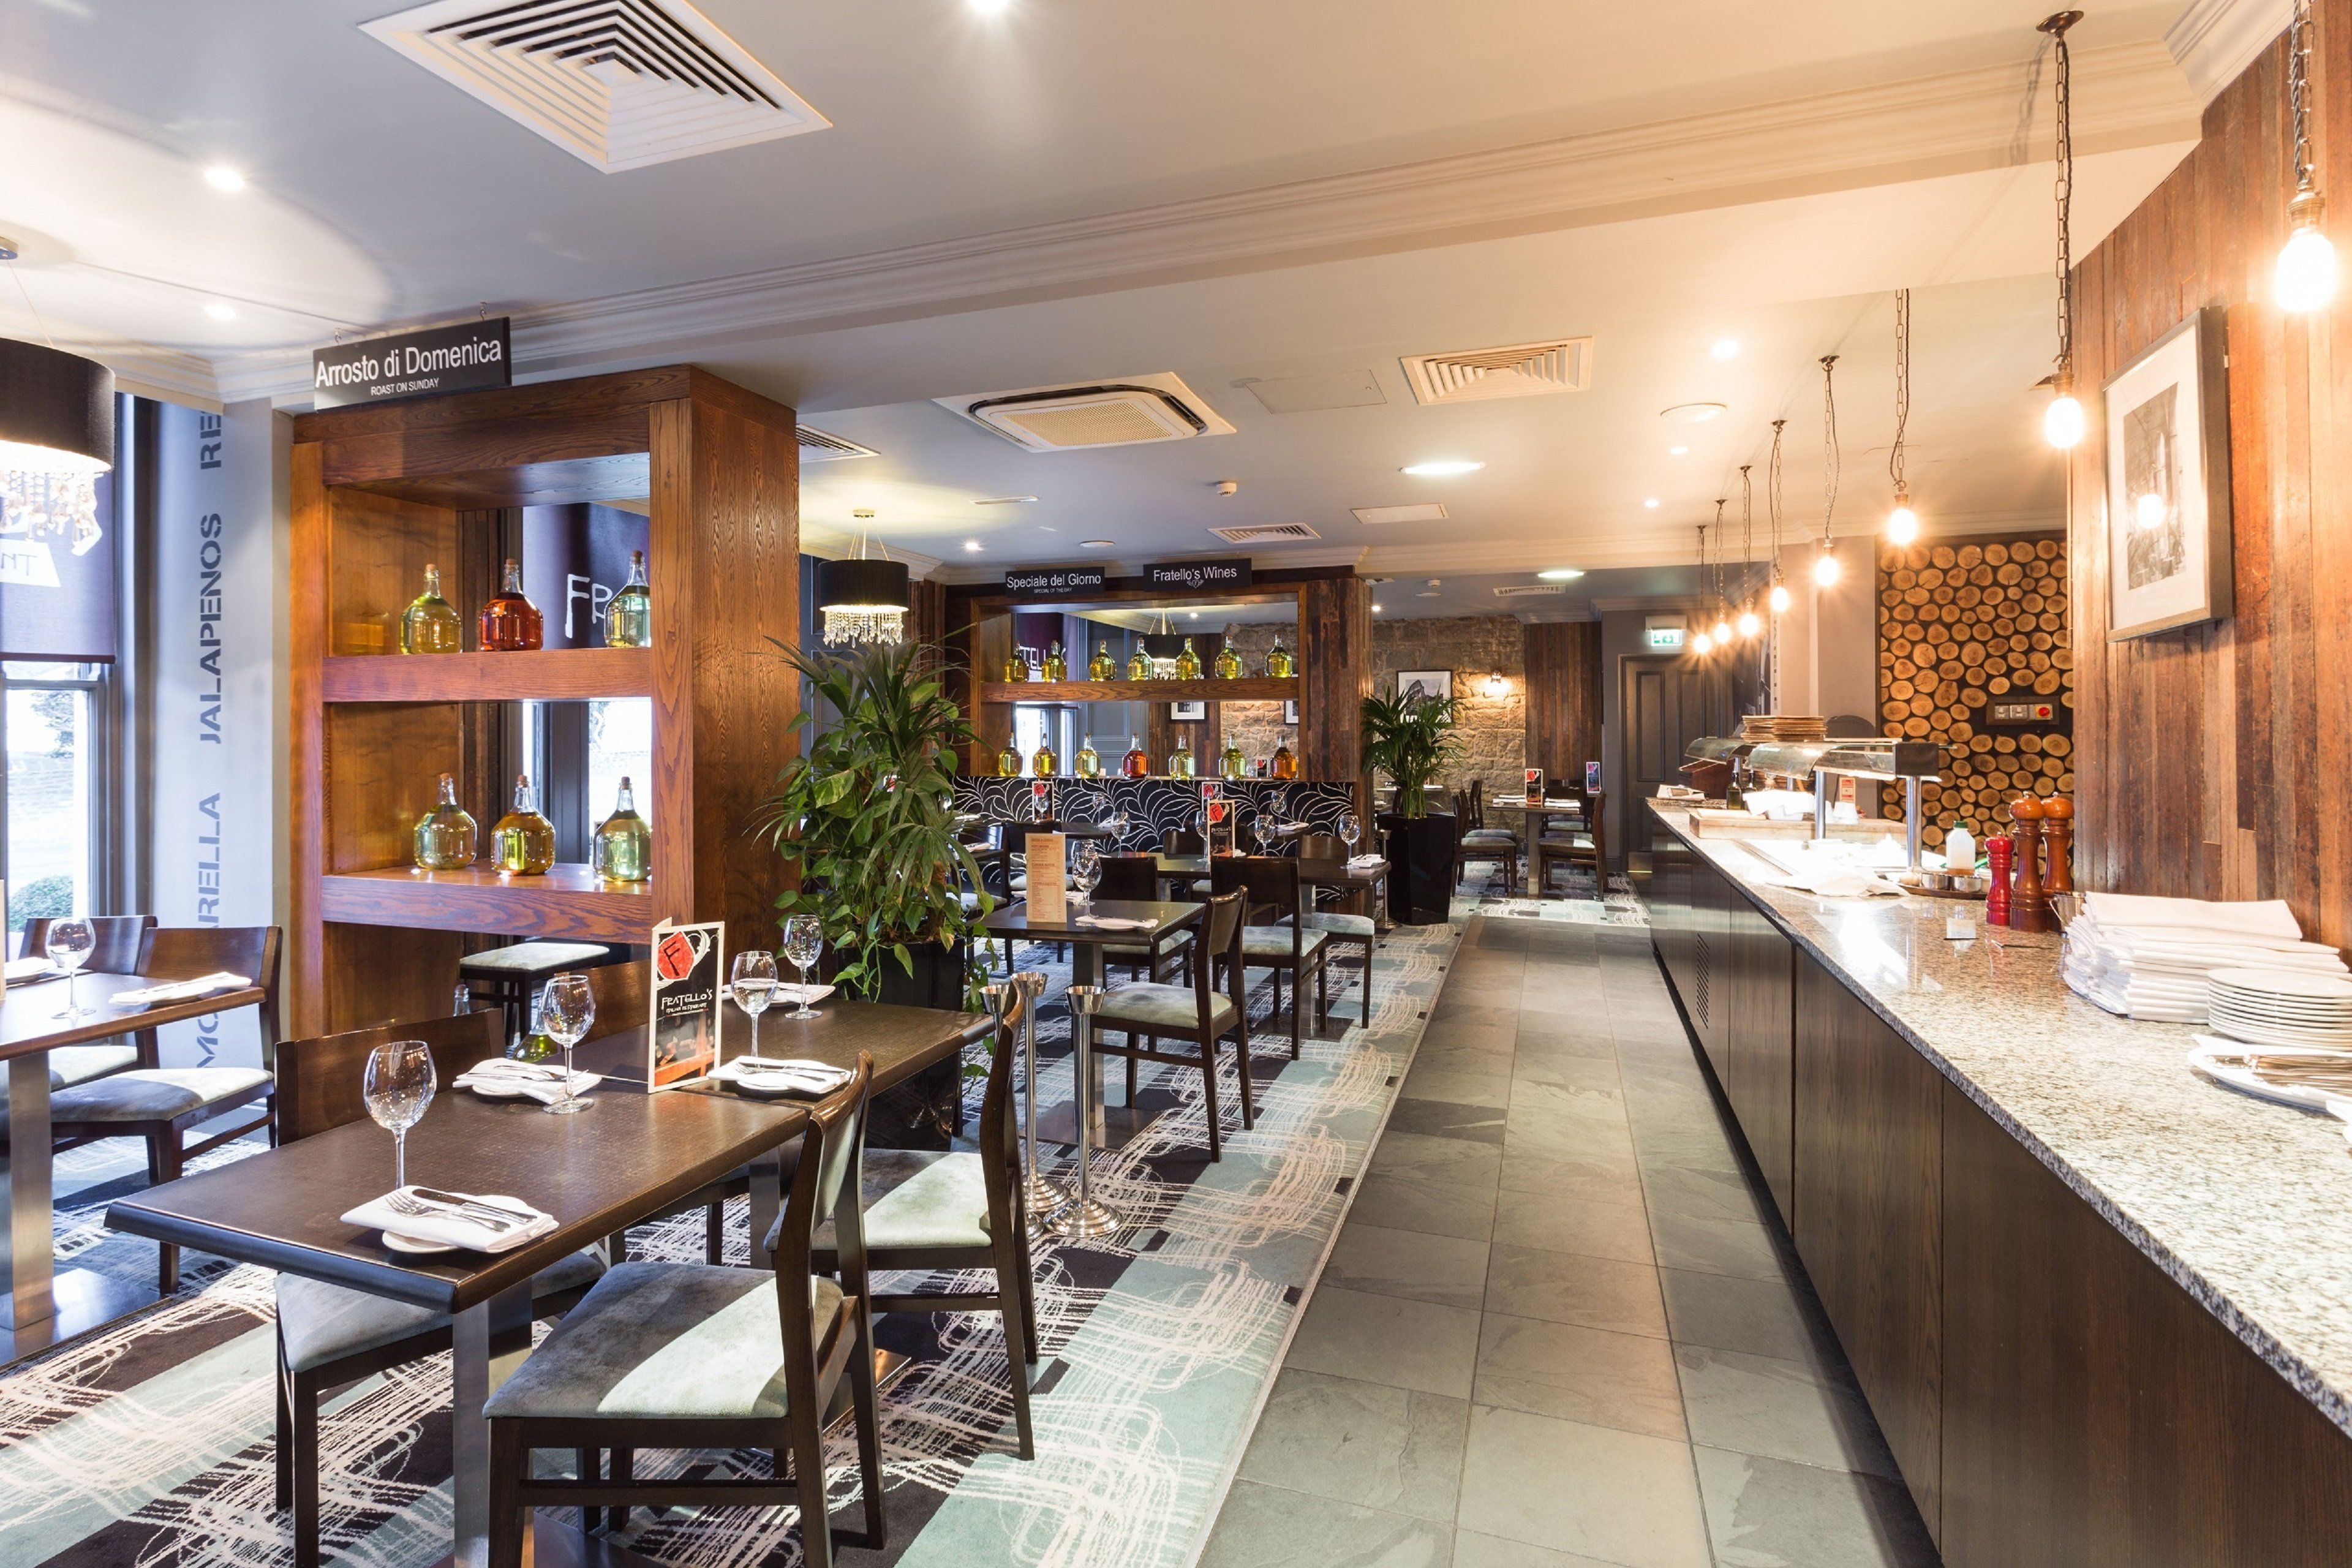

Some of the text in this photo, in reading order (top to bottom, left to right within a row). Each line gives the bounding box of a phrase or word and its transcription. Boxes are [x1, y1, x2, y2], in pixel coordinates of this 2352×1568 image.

[315, 336, 501, 388] Arrosto di Domenica
[371, 377, 439, 396] ROAST ON SUNDAY
[200, 411, 221, 469] RE
[1007, 573, 1101, 590] Speciale del Giorno
[1153, 567, 1237, 581] Fratello's Wines
[200, 513, 221, 744] JALAPENOS
[663, 941, 680, 976] F
[661, 988, 712, 1011] FRATELLO'S
